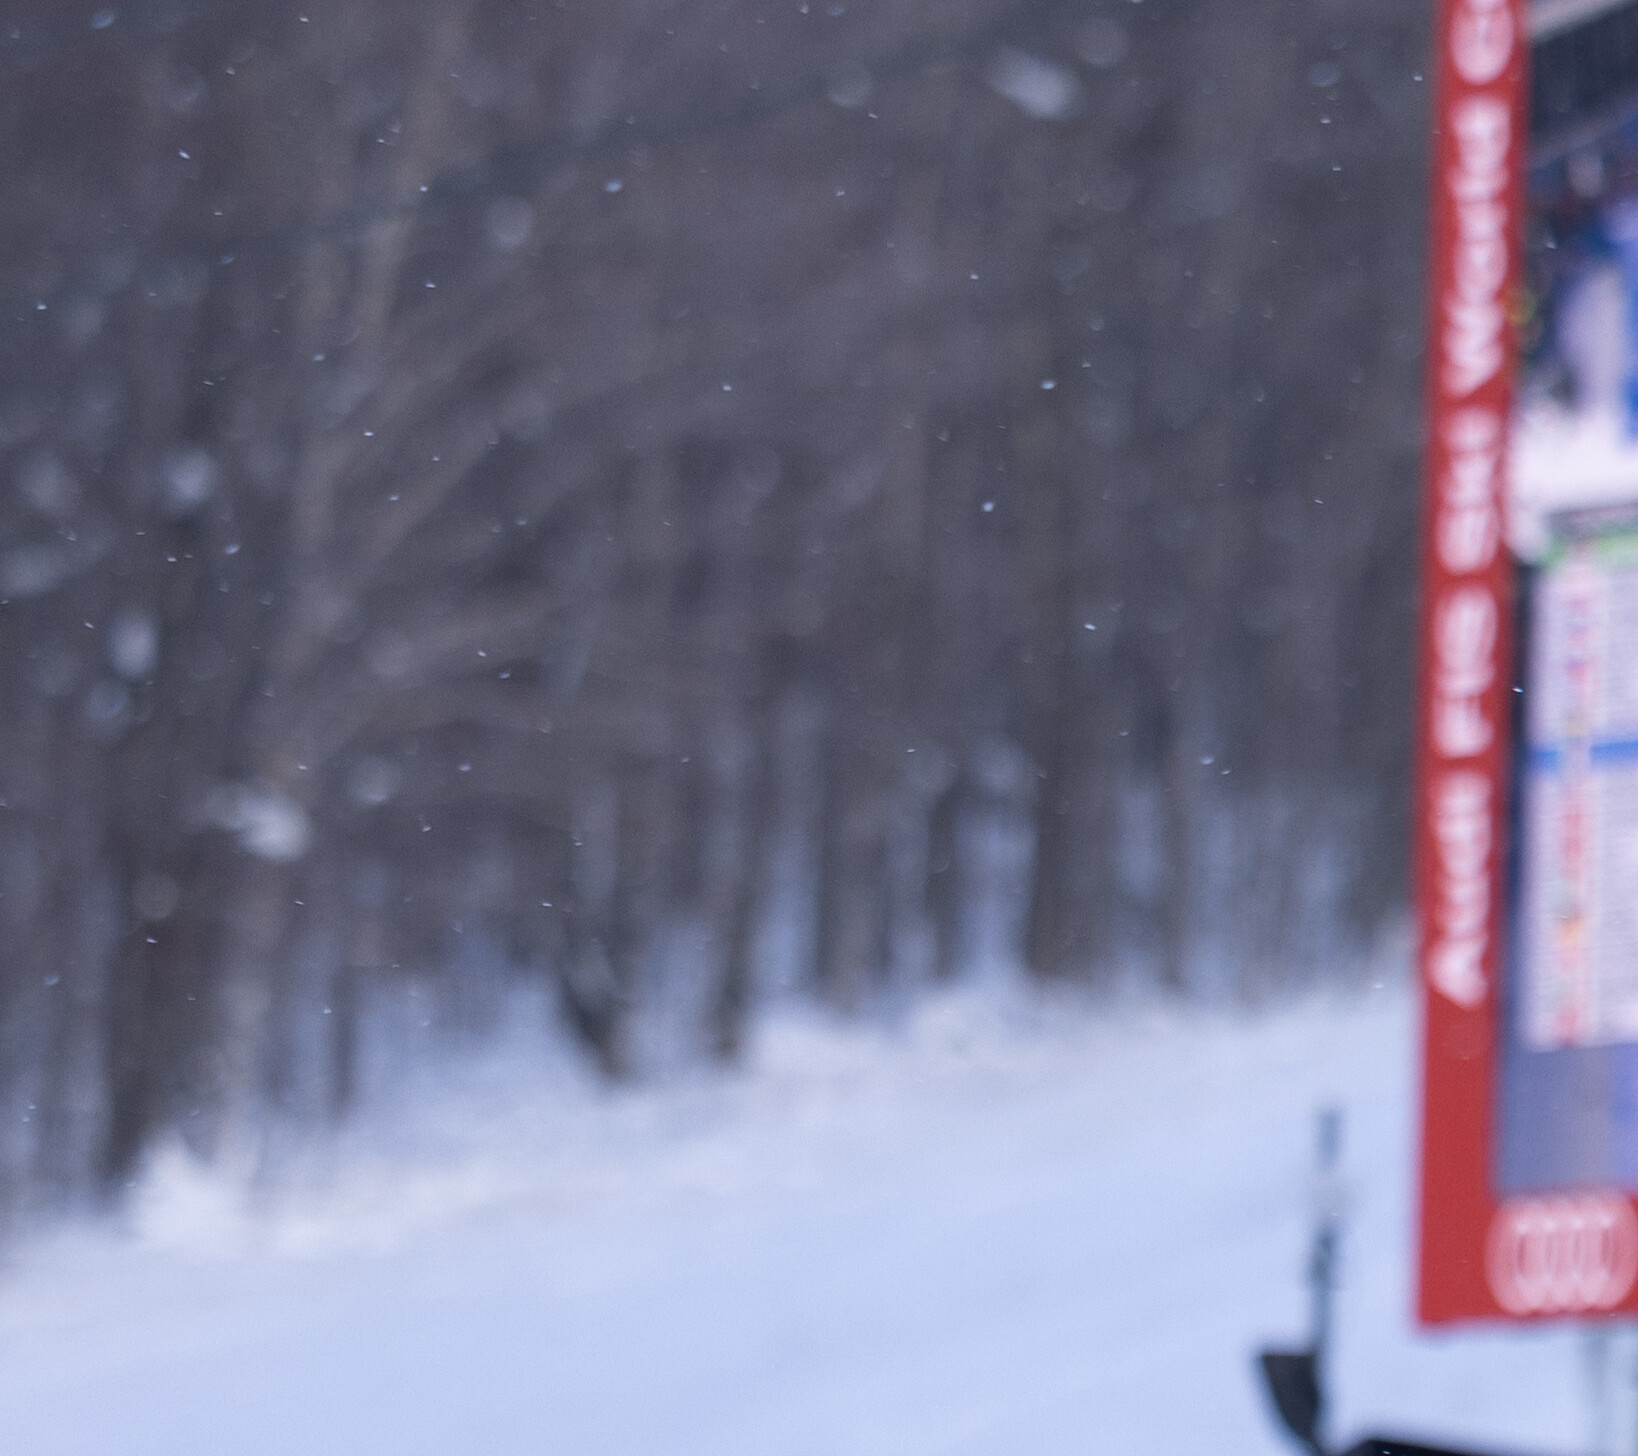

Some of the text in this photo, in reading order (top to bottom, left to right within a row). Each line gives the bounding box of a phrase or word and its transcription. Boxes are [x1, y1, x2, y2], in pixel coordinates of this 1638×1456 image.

[1441, 98, 1512, 394] World
[1437, 410, 1502, 573] Ski
[1431, 589, 1499, 757] FIS
[1426, 772, 1496, 1008] Audi
